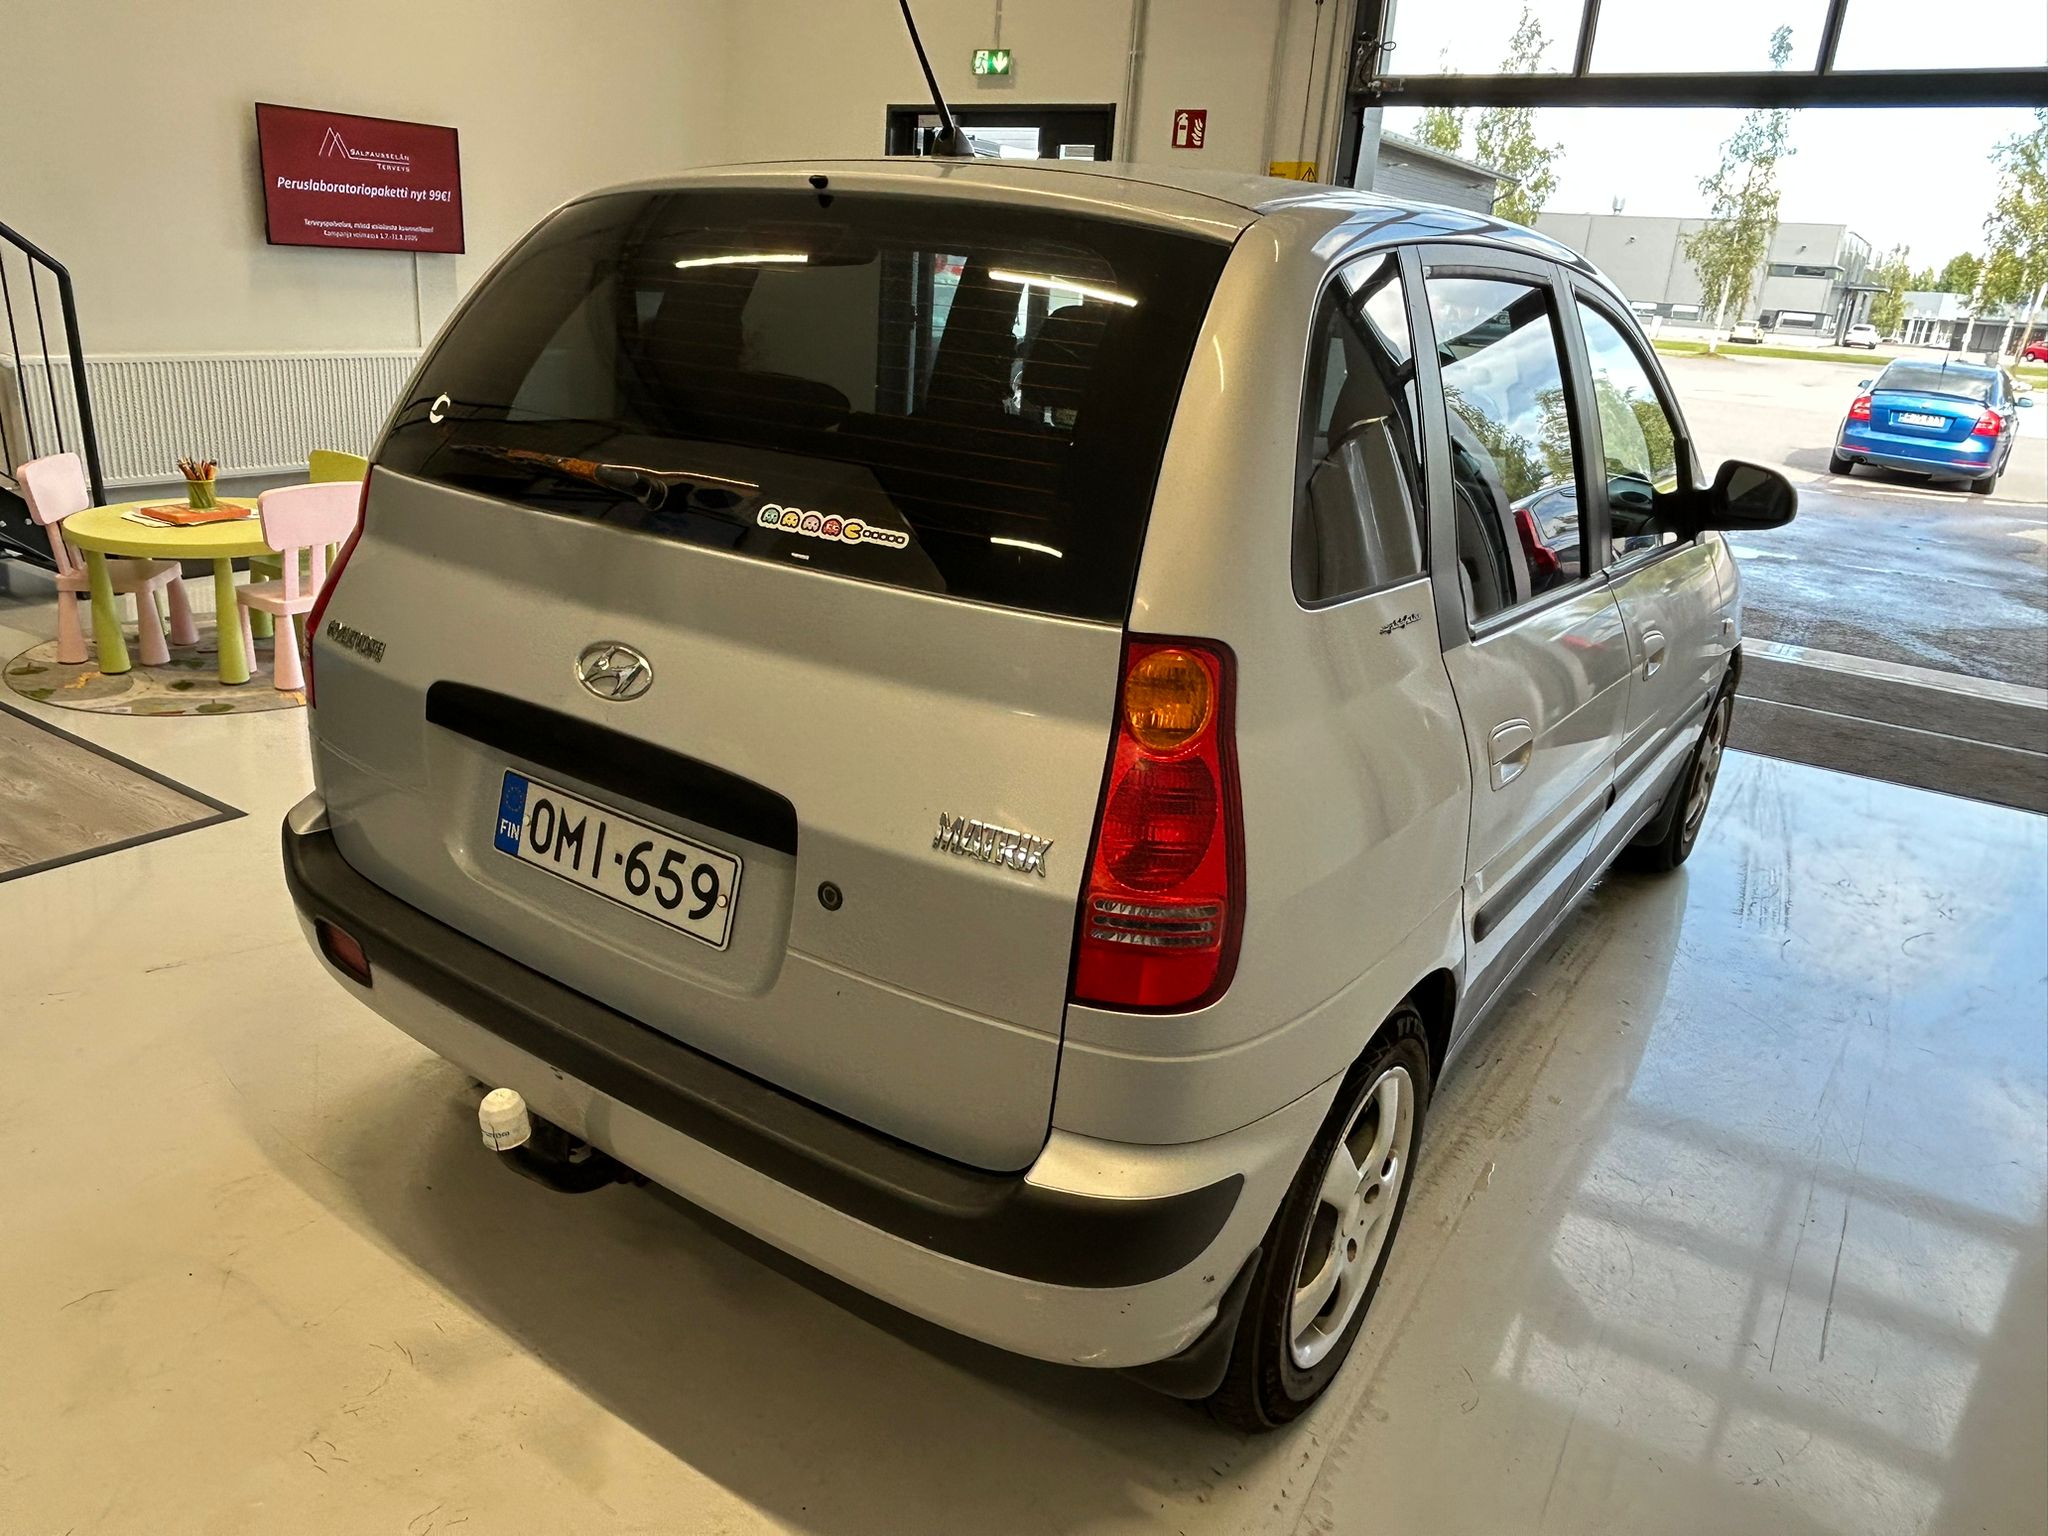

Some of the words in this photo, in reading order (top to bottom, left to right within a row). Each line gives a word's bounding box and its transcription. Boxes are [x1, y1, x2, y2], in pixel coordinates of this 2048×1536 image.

[277, 176, 408, 199] Peruslaboratoriopaketti
[410, 189, 427, 202] nyt
[429, 190, 451, 202] 99€!
[499, 817, 521, 842] FIN
[931, 810, 1055, 879] MATRIX
[529, 798, 721, 921] OMI-659
